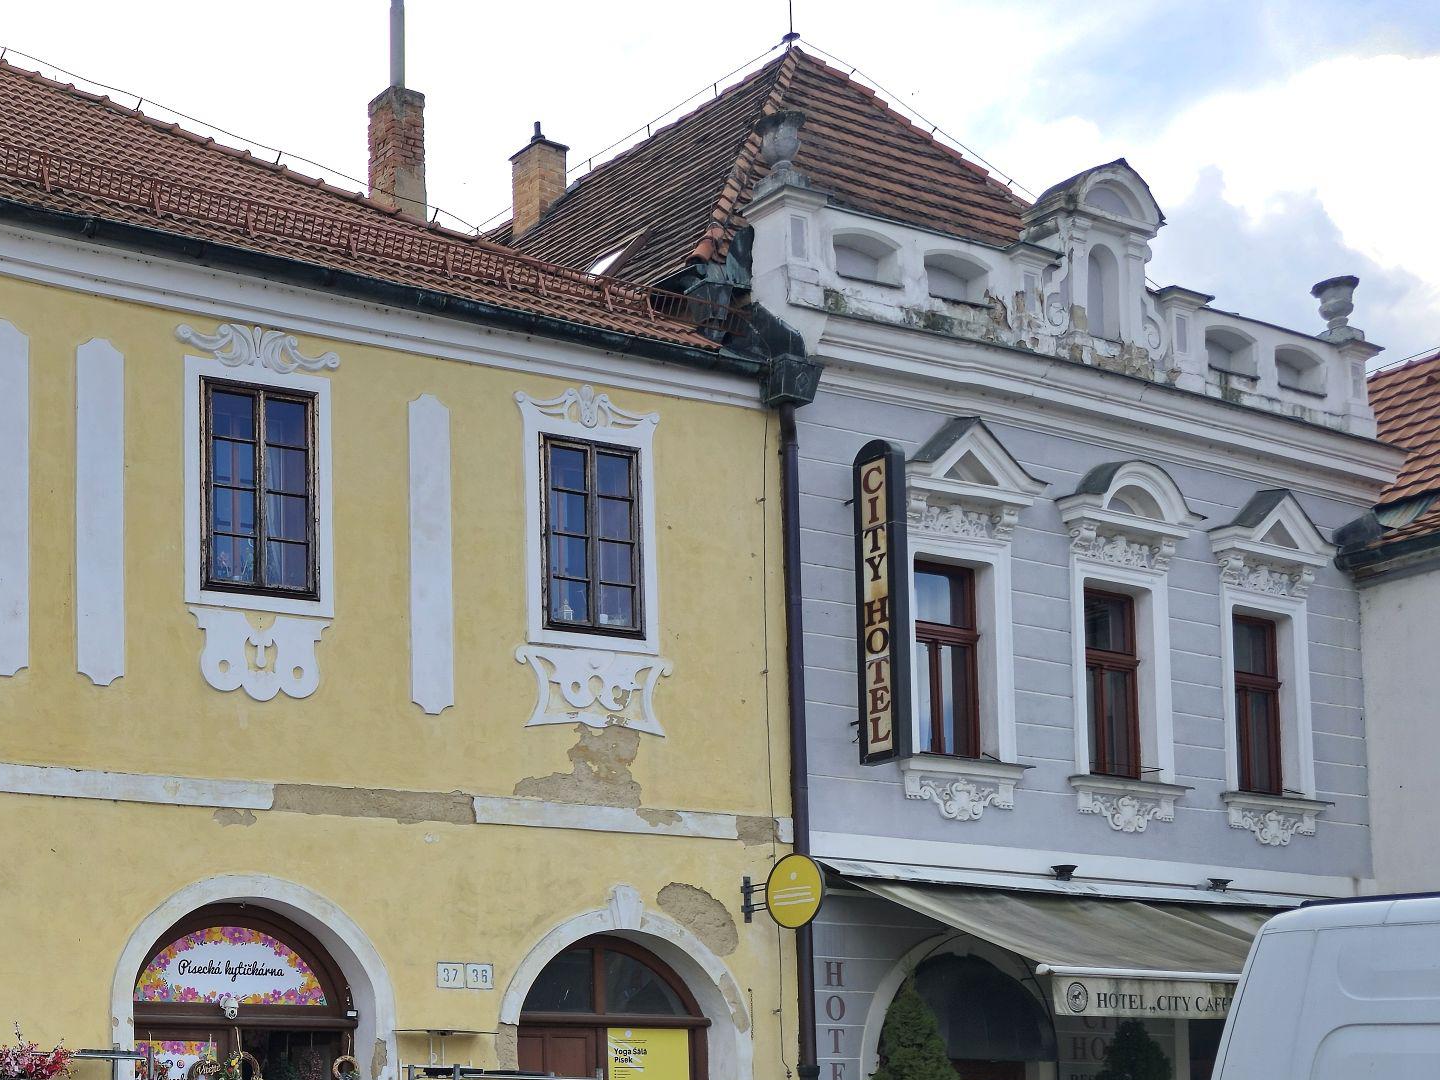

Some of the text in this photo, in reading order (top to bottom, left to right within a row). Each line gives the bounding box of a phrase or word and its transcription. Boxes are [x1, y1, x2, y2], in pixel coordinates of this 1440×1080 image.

[863, 466, 890, 744] CITY HOTEL
[178, 959, 285, 982] Písecká kytičkárna
[443, 967, 458, 983] 37
[1096, 992, 1149, 1010] HOTEL
[614, 1047, 631, 1056] Yoga
